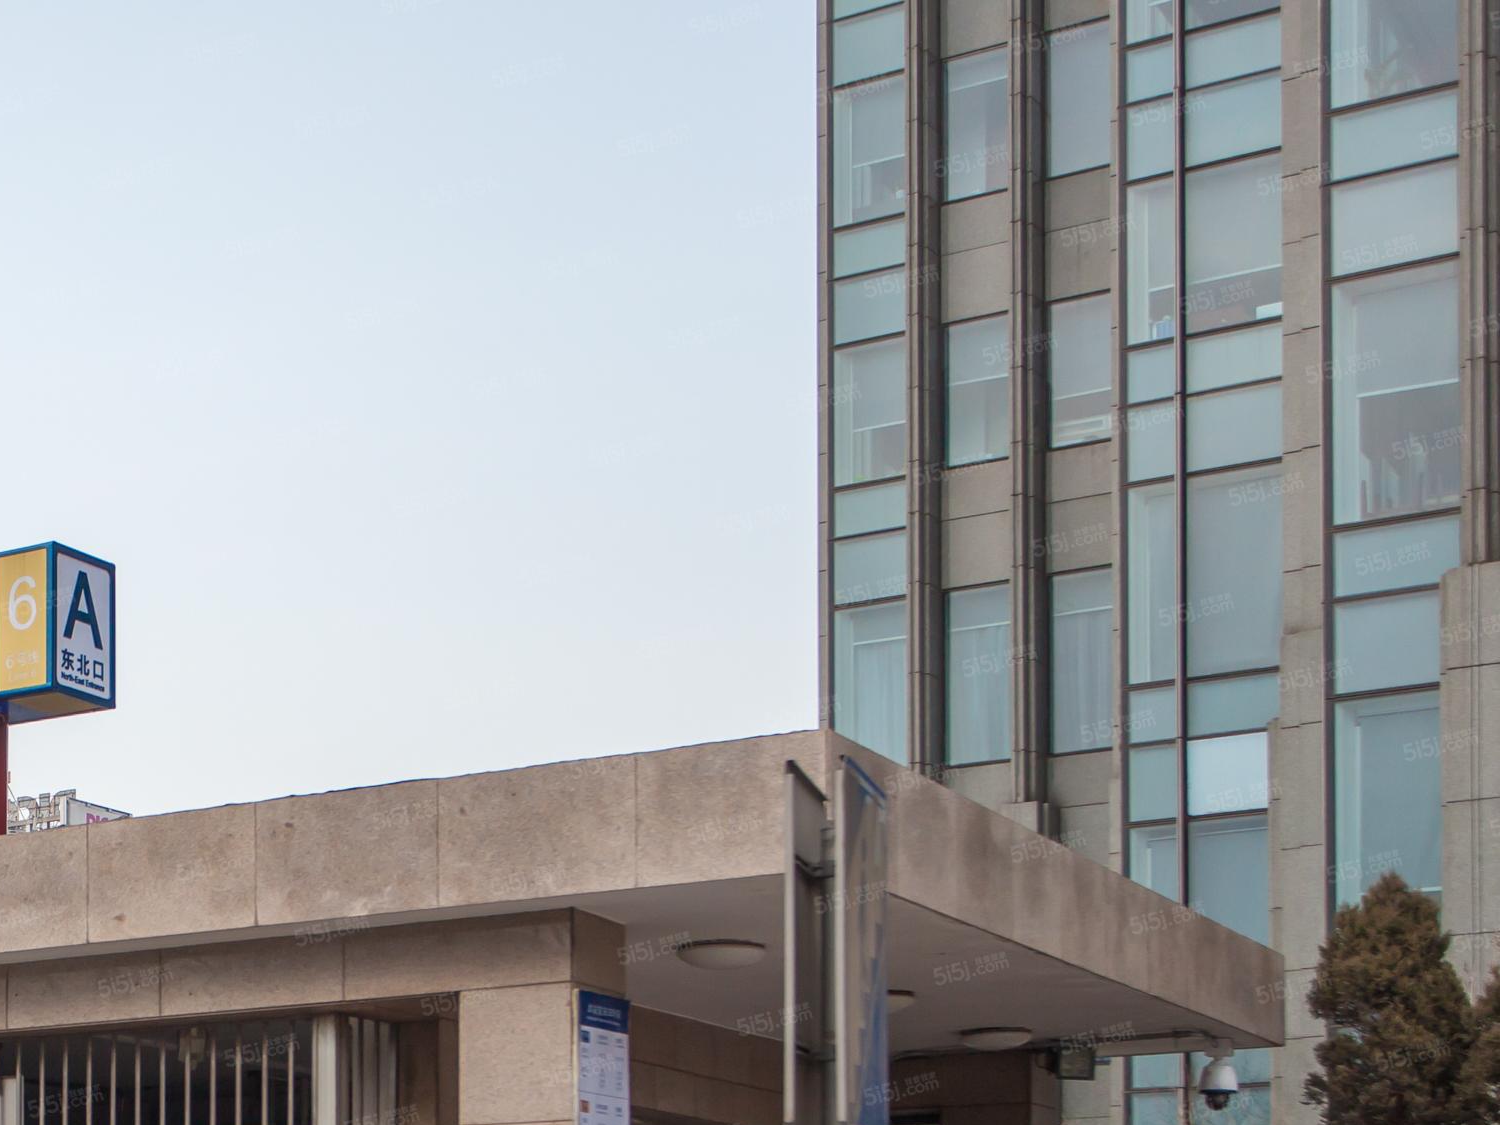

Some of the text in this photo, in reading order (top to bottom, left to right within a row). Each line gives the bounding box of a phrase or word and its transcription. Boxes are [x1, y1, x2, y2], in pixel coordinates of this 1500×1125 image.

[8, 575, 37, 630] 6
[63, 570, 103, 651] A
[61, 648, 104, 682] 东北口
